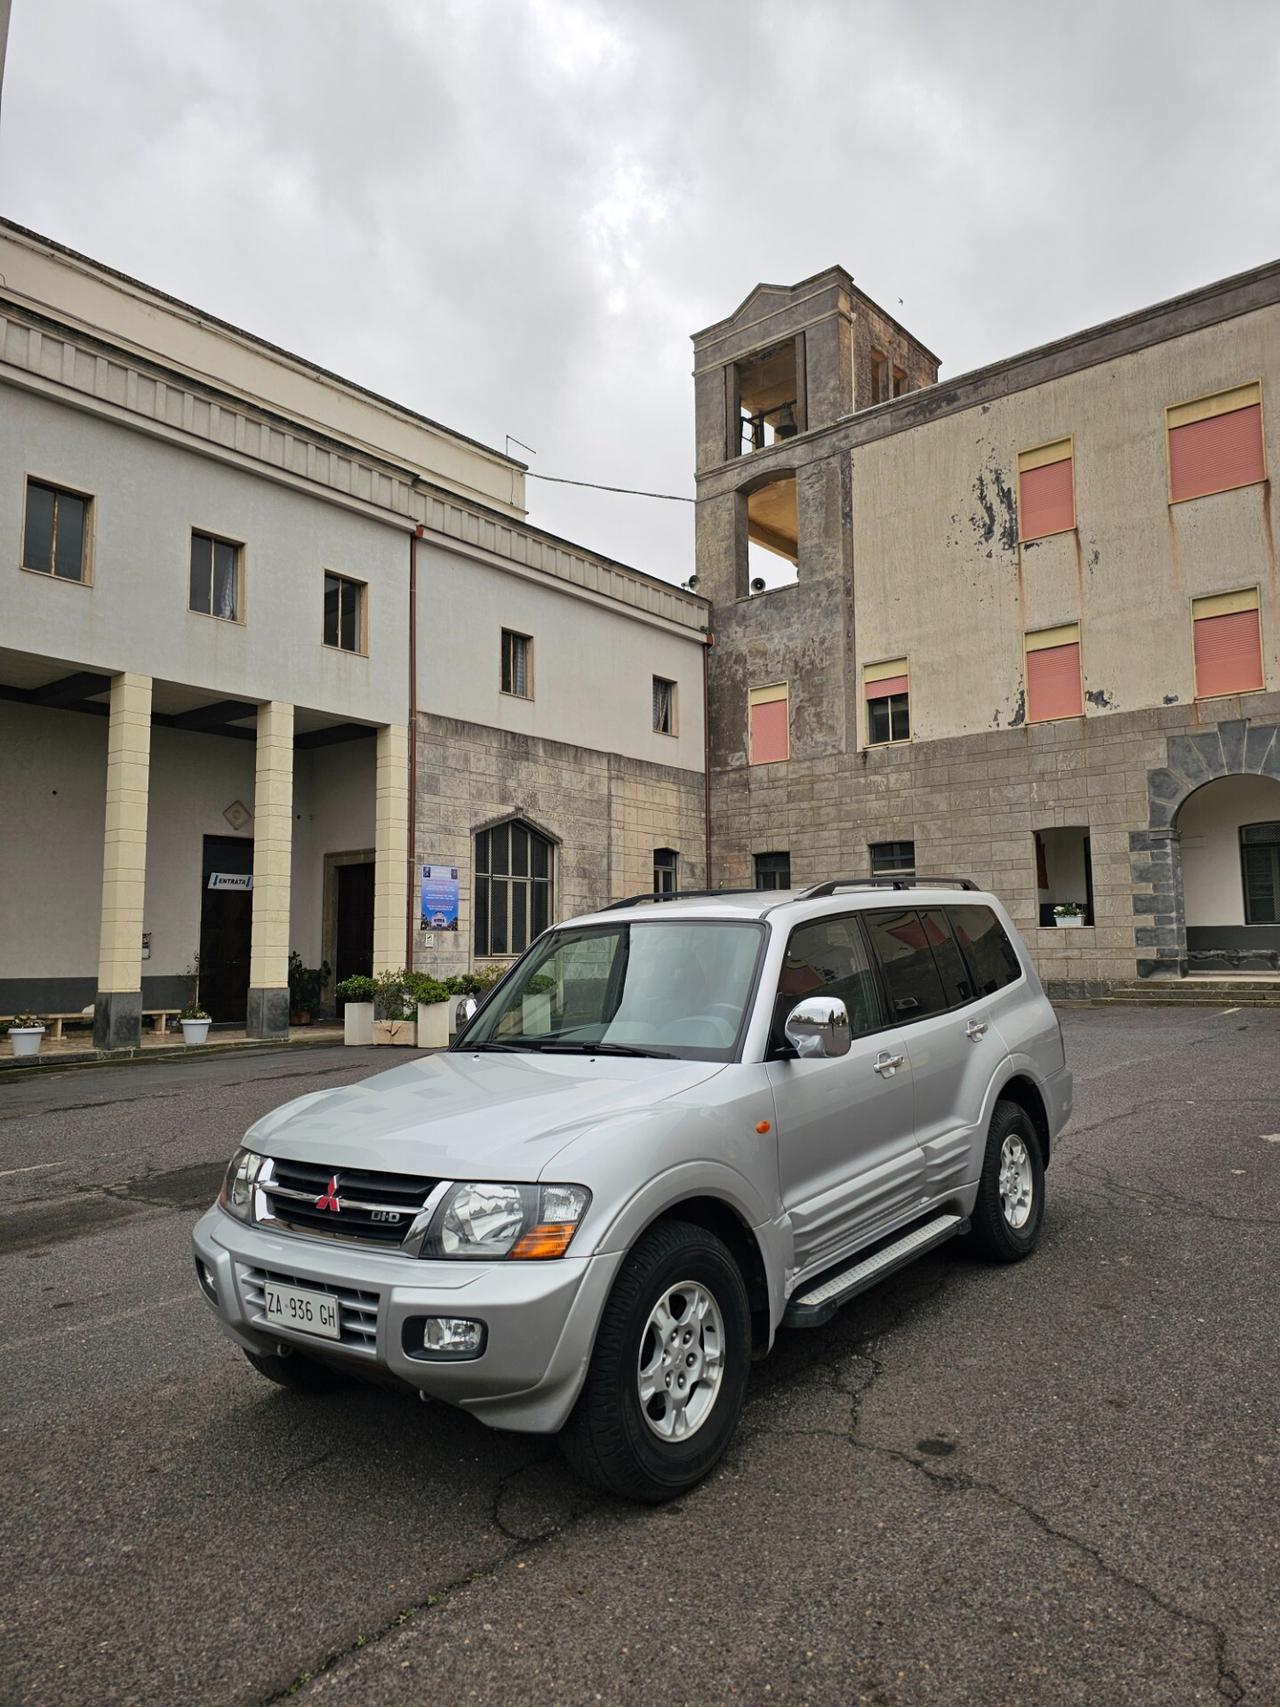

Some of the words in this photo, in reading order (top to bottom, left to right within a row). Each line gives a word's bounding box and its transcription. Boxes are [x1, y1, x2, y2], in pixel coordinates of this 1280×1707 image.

[267, 1292, 282, 1315] ZA
[289, 1297, 313, 1321] 936
[320, 1304, 336, 1328] GH
